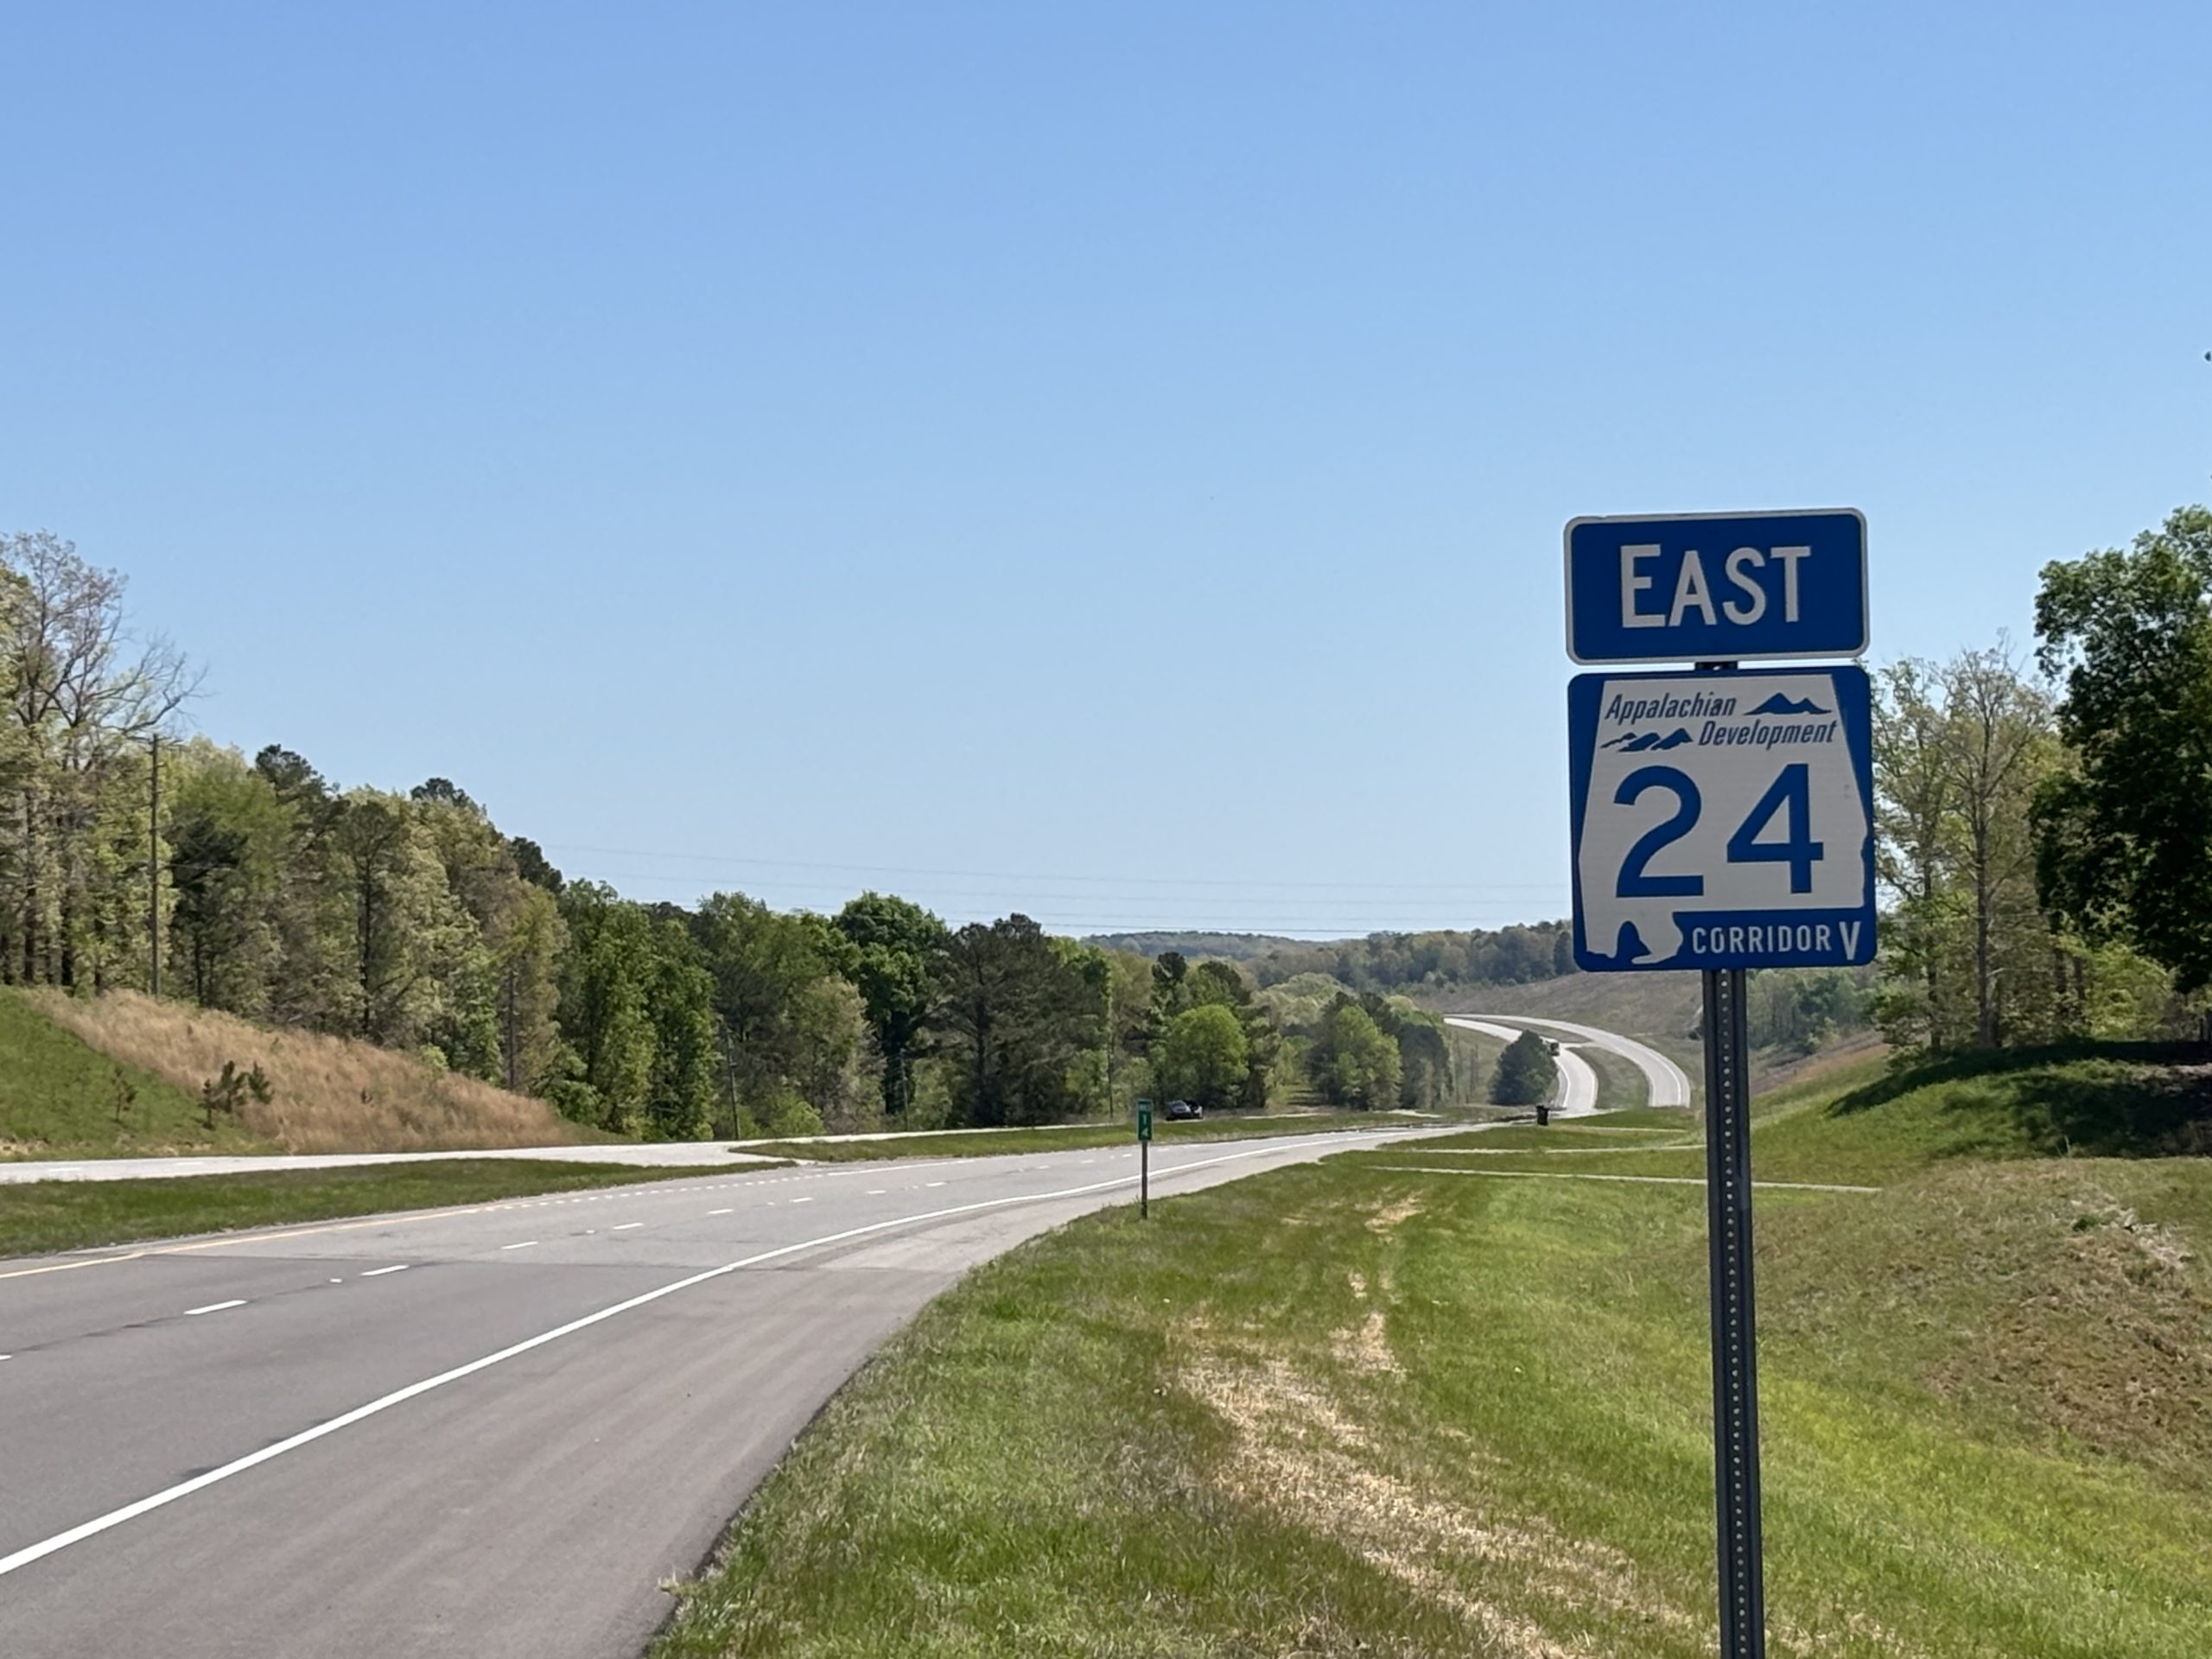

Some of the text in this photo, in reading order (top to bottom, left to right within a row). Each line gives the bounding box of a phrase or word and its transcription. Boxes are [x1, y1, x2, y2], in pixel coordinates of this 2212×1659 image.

[1620, 544, 1811, 628] EAST
[1605, 692, 1737, 725] Appalachian
[1698, 720, 1837, 750] Development
[1613, 763, 1824, 898] 24
[1692, 921, 1861, 961] CORRIDOR V
